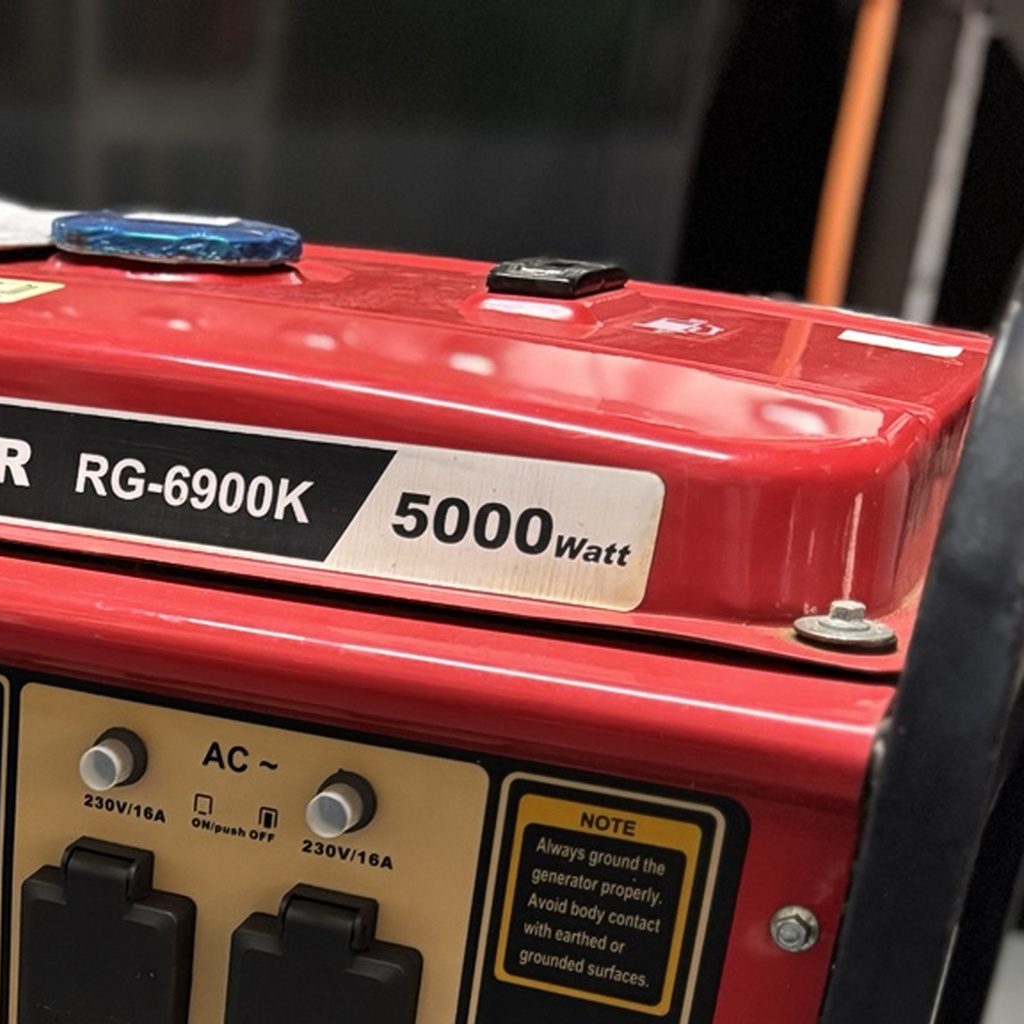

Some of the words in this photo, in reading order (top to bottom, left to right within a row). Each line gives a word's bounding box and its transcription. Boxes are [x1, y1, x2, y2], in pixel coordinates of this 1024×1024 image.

[75, 451, 315, 524] RG-6900K
[202, 740, 249, 774] AC
[83, 793, 166, 824] 230V/16A
[580, 811, 637, 837] NOTE
[191, 816, 247, 839] ON/push
[248, 829, 276, 844] OFF
[301, 839, 394, 871] 230V/16A
[534, 836, 586, 863] Always
[588, 848, 641, 872] ground
[642, 857, 667, 877] the
[531, 867, 599, 892] generator
[599, 880, 663, 909] properly.
[527, 891, 568, 915] Avoid
[569, 900, 606, 926] body
[607, 910, 662, 935] contact
[523, 919, 553, 940] with
[554, 926, 608, 952] earthed
[610, 940, 627, 956] or
[518, 948, 586, 974] grounded
[586, 962, 651, 989] surfaces.
